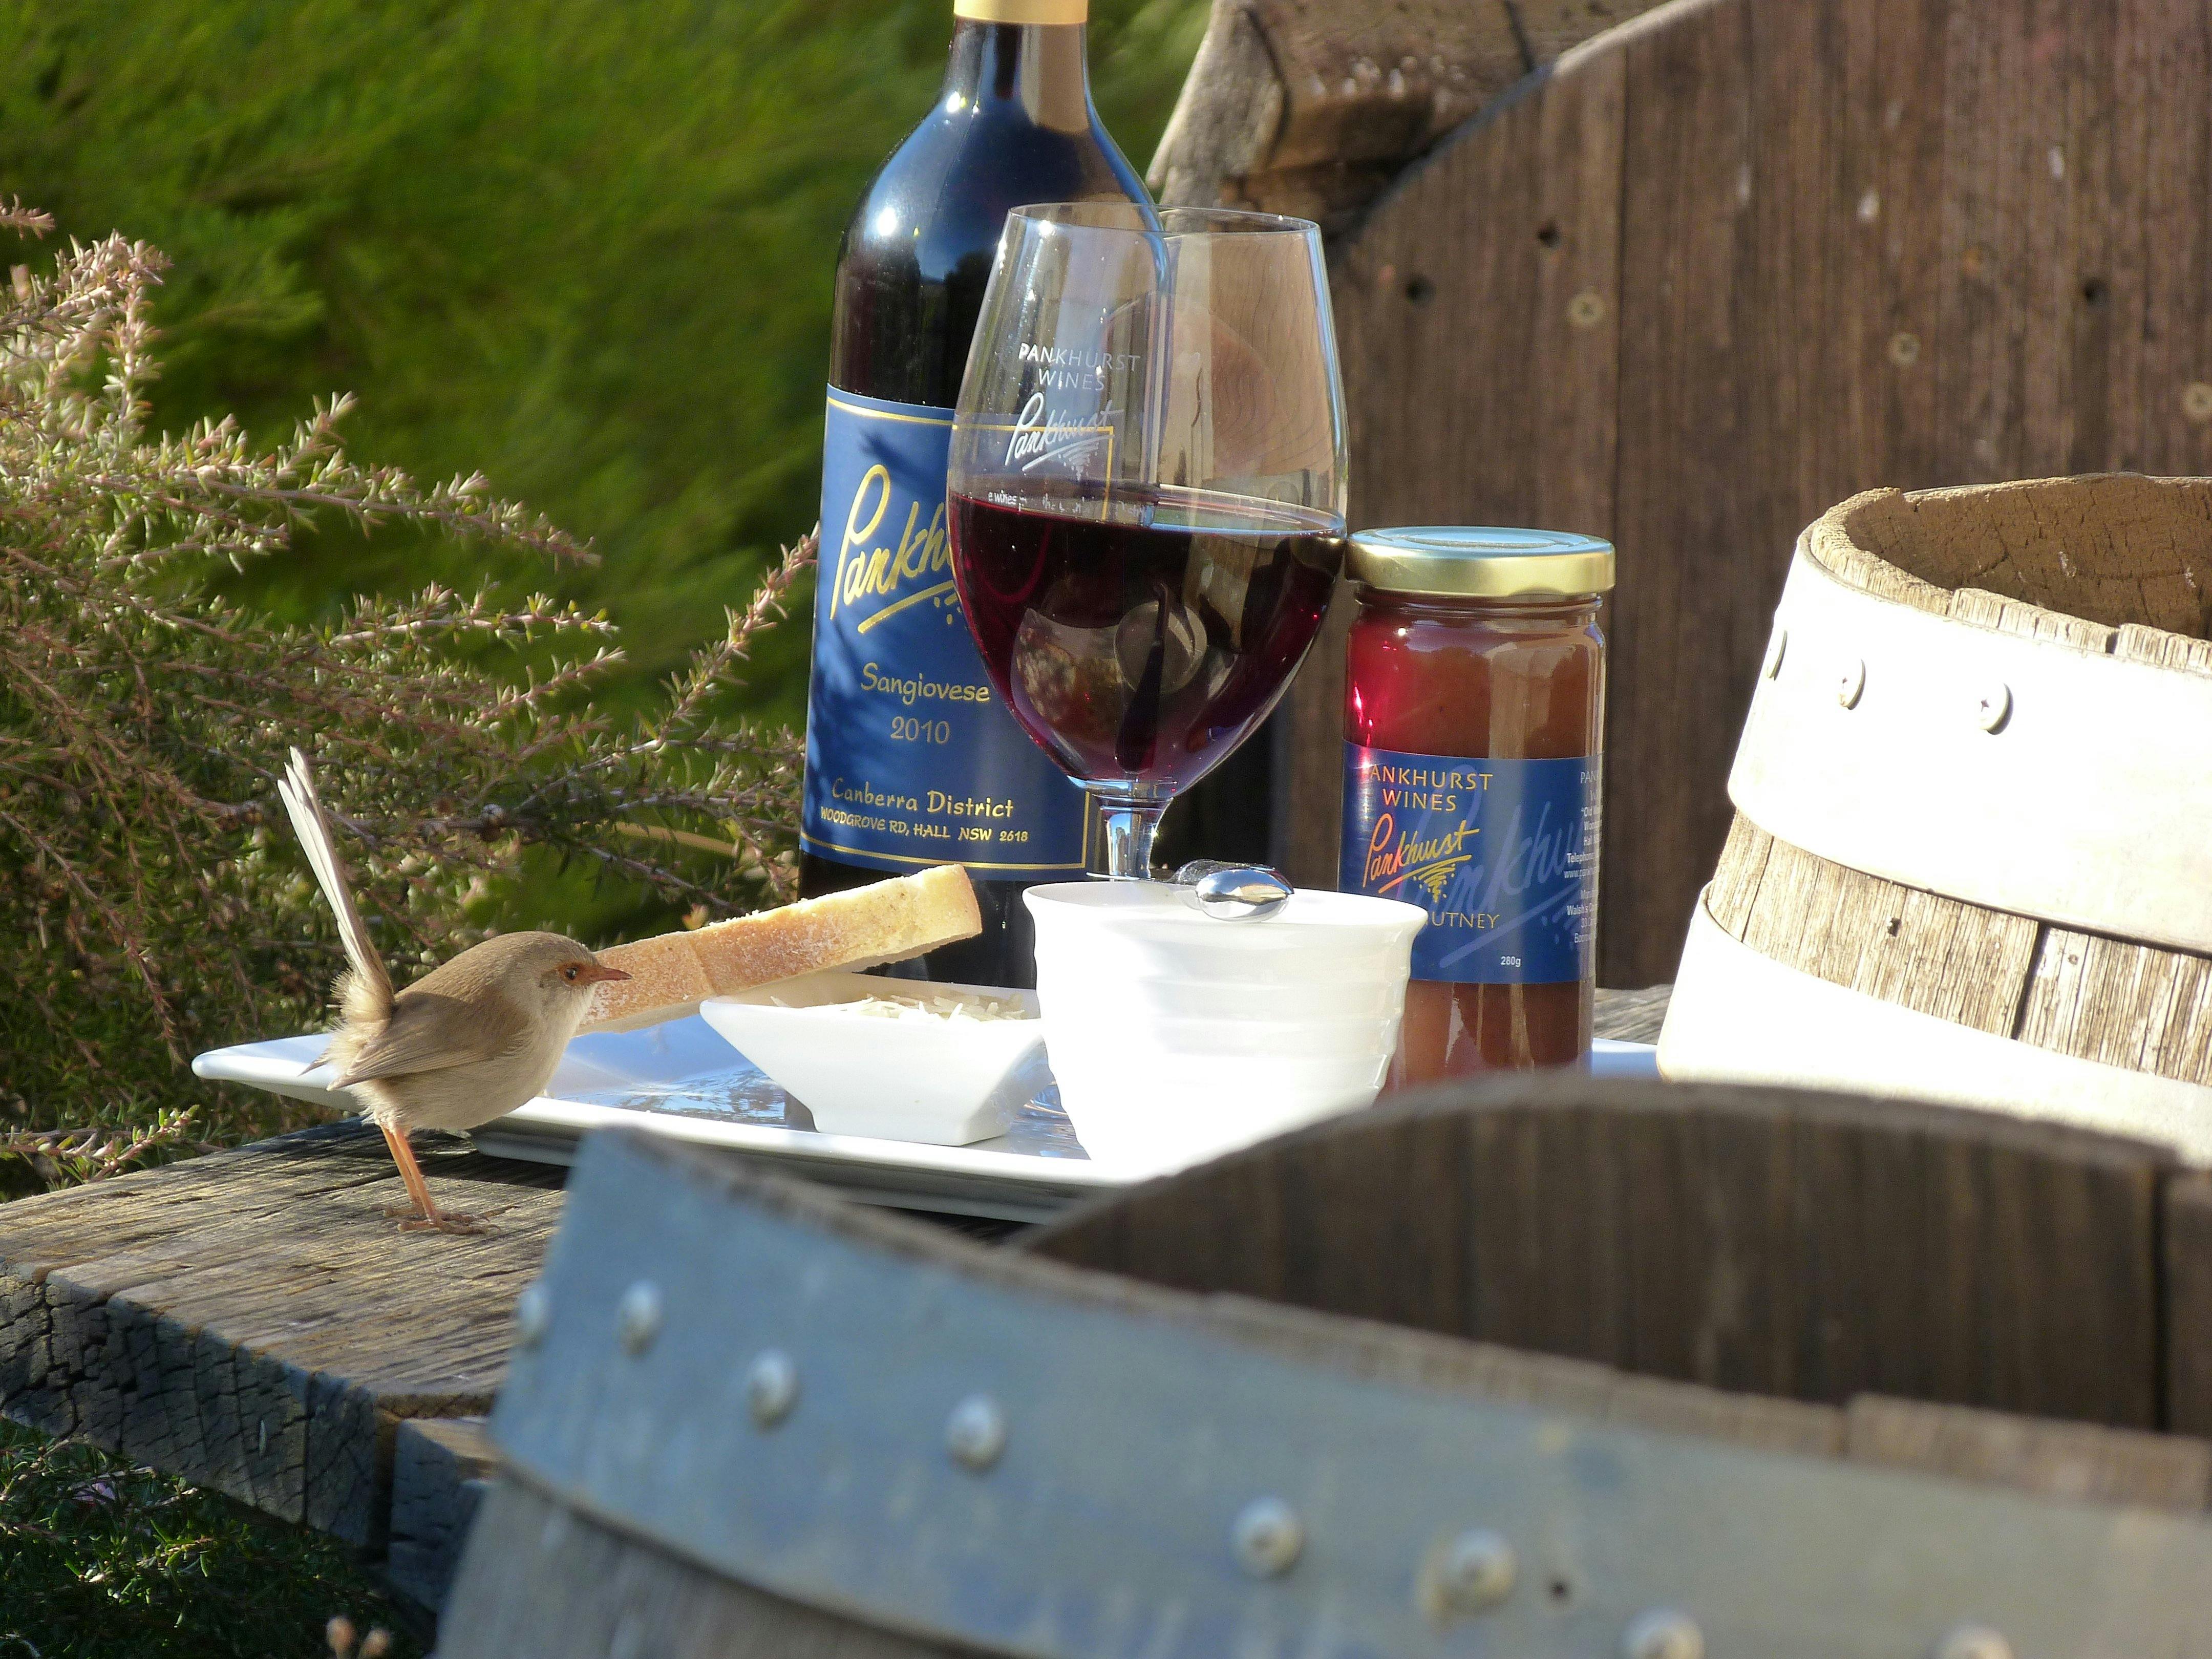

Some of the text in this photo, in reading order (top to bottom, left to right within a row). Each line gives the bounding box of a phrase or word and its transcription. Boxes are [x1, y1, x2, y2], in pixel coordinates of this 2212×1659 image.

[1018, 342, 1141, 372] PANKHURST
[1038, 368, 1106, 391] WINES
[830, 463, 952, 620] Pankh
[860, 662, 990, 706] Sangiovese
[890, 716, 951, 745] 2010
[1370, 763, 1494, 791] ANKHURST
[831, 777, 1014, 818] Canberra District
[1382, 788, 1457, 813] WINES
[821, 806, 1029, 843] WOODGROVE RD, HALL NSW 2618
[1363, 813, 1480, 888] Pankhurst
[1426, 911, 1500, 929] UTNEY
[1500, 956, 1521, 967] 280g
